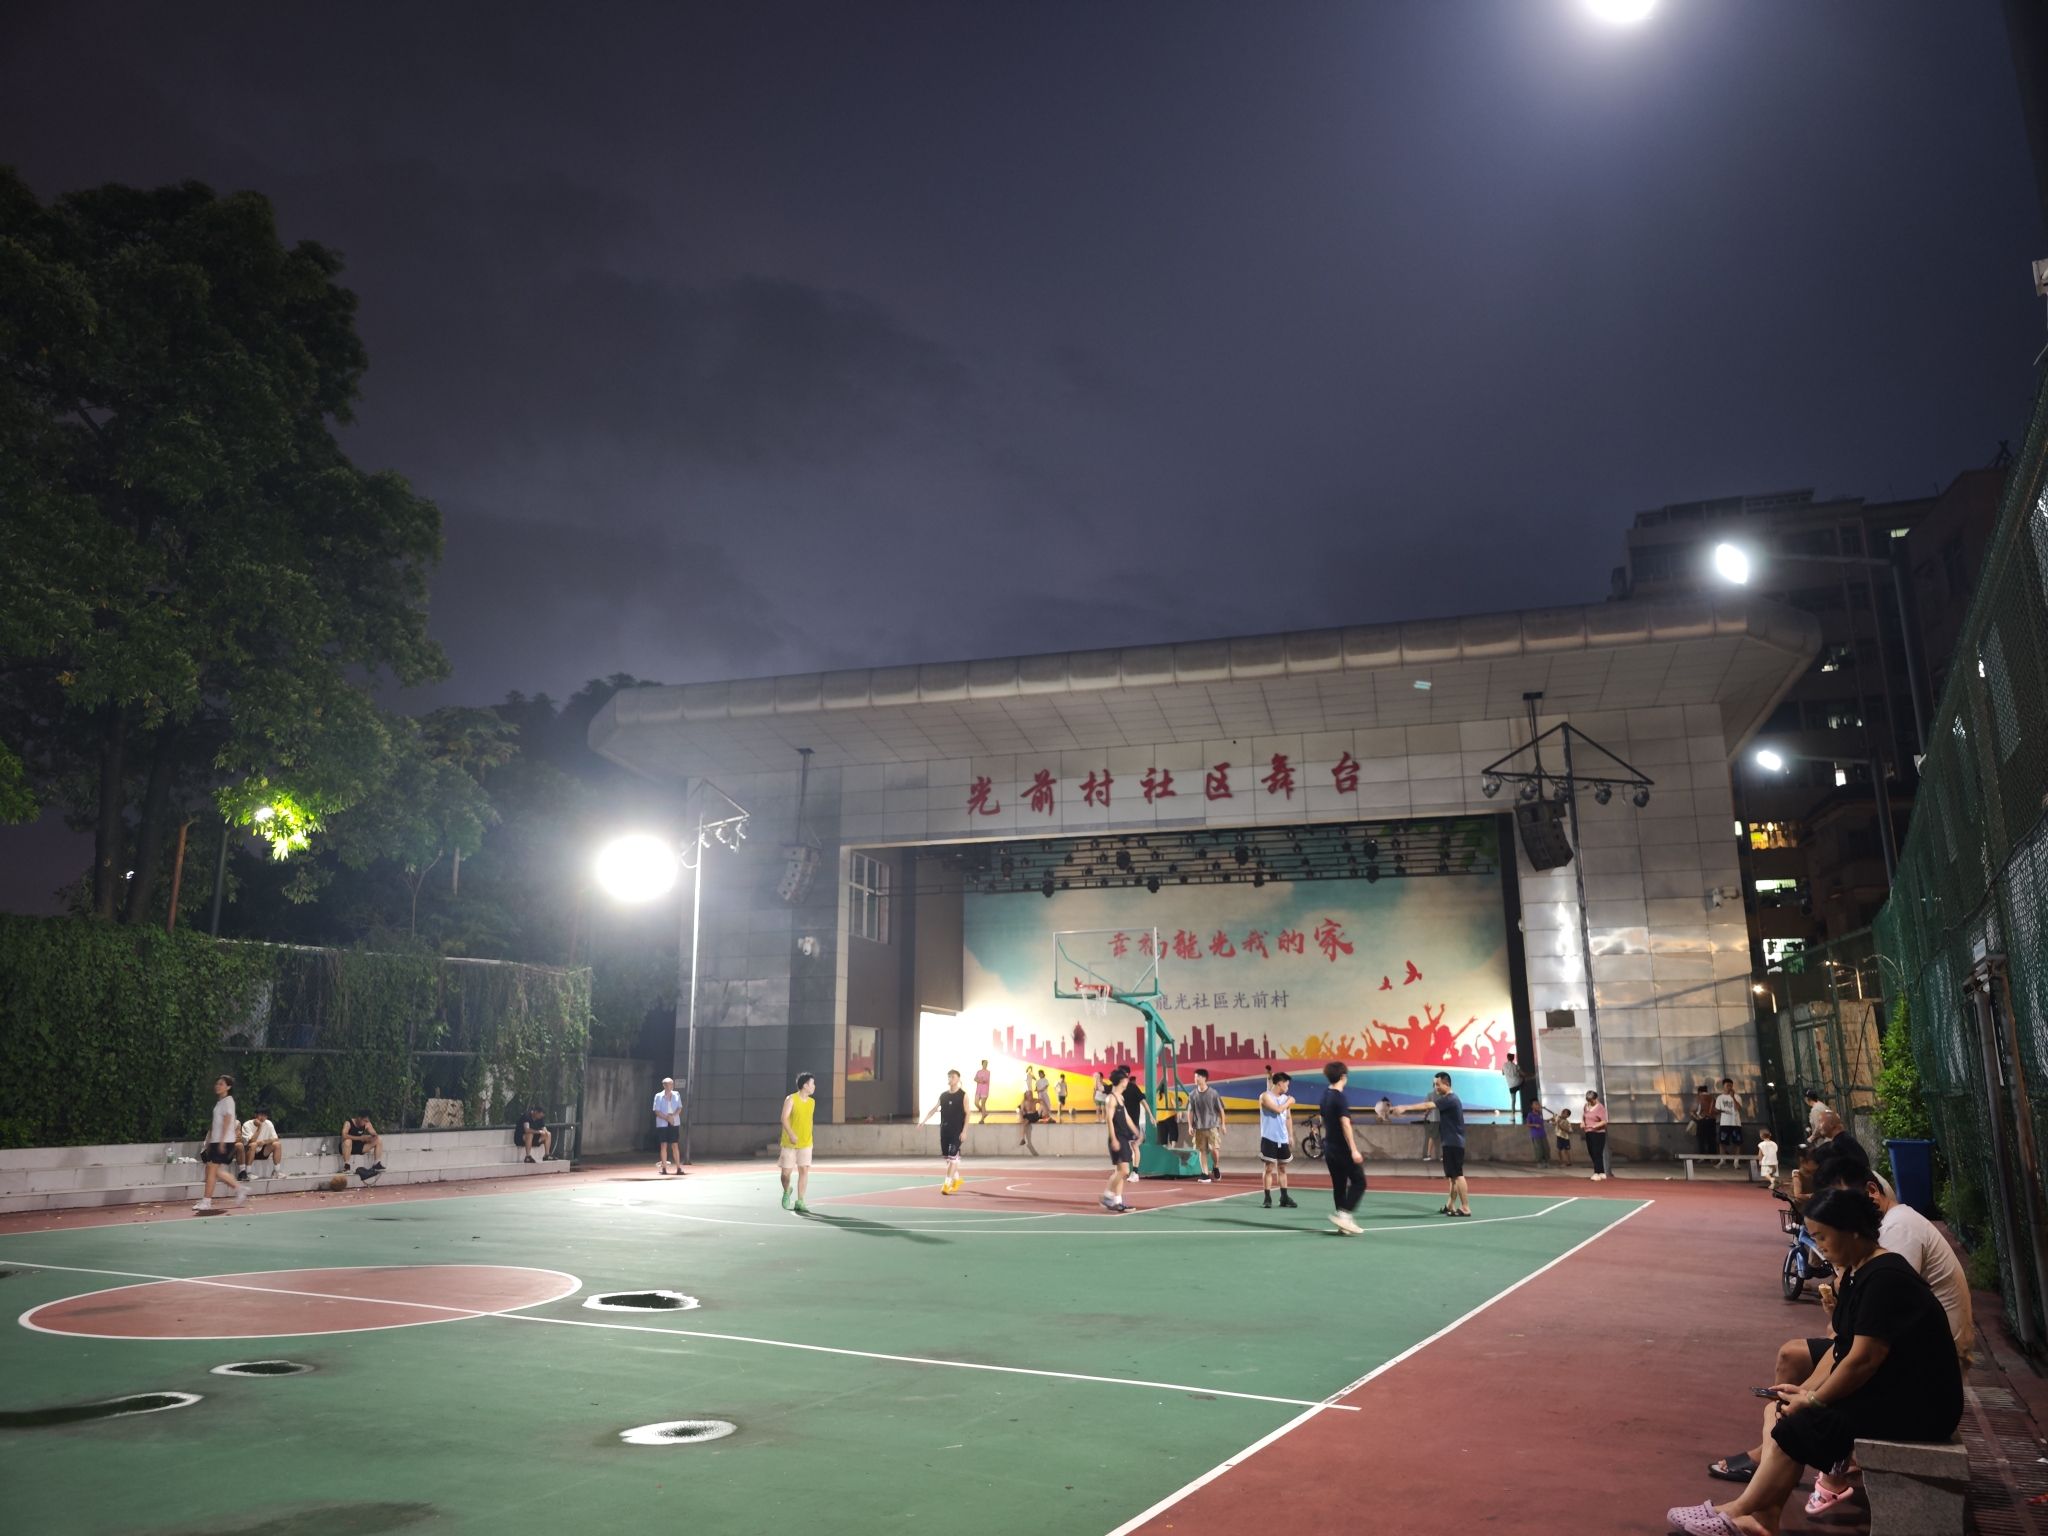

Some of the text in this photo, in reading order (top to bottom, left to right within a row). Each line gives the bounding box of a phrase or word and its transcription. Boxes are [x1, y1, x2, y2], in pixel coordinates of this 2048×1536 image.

[966, 751, 1361, 817] 光前村社区舞台
